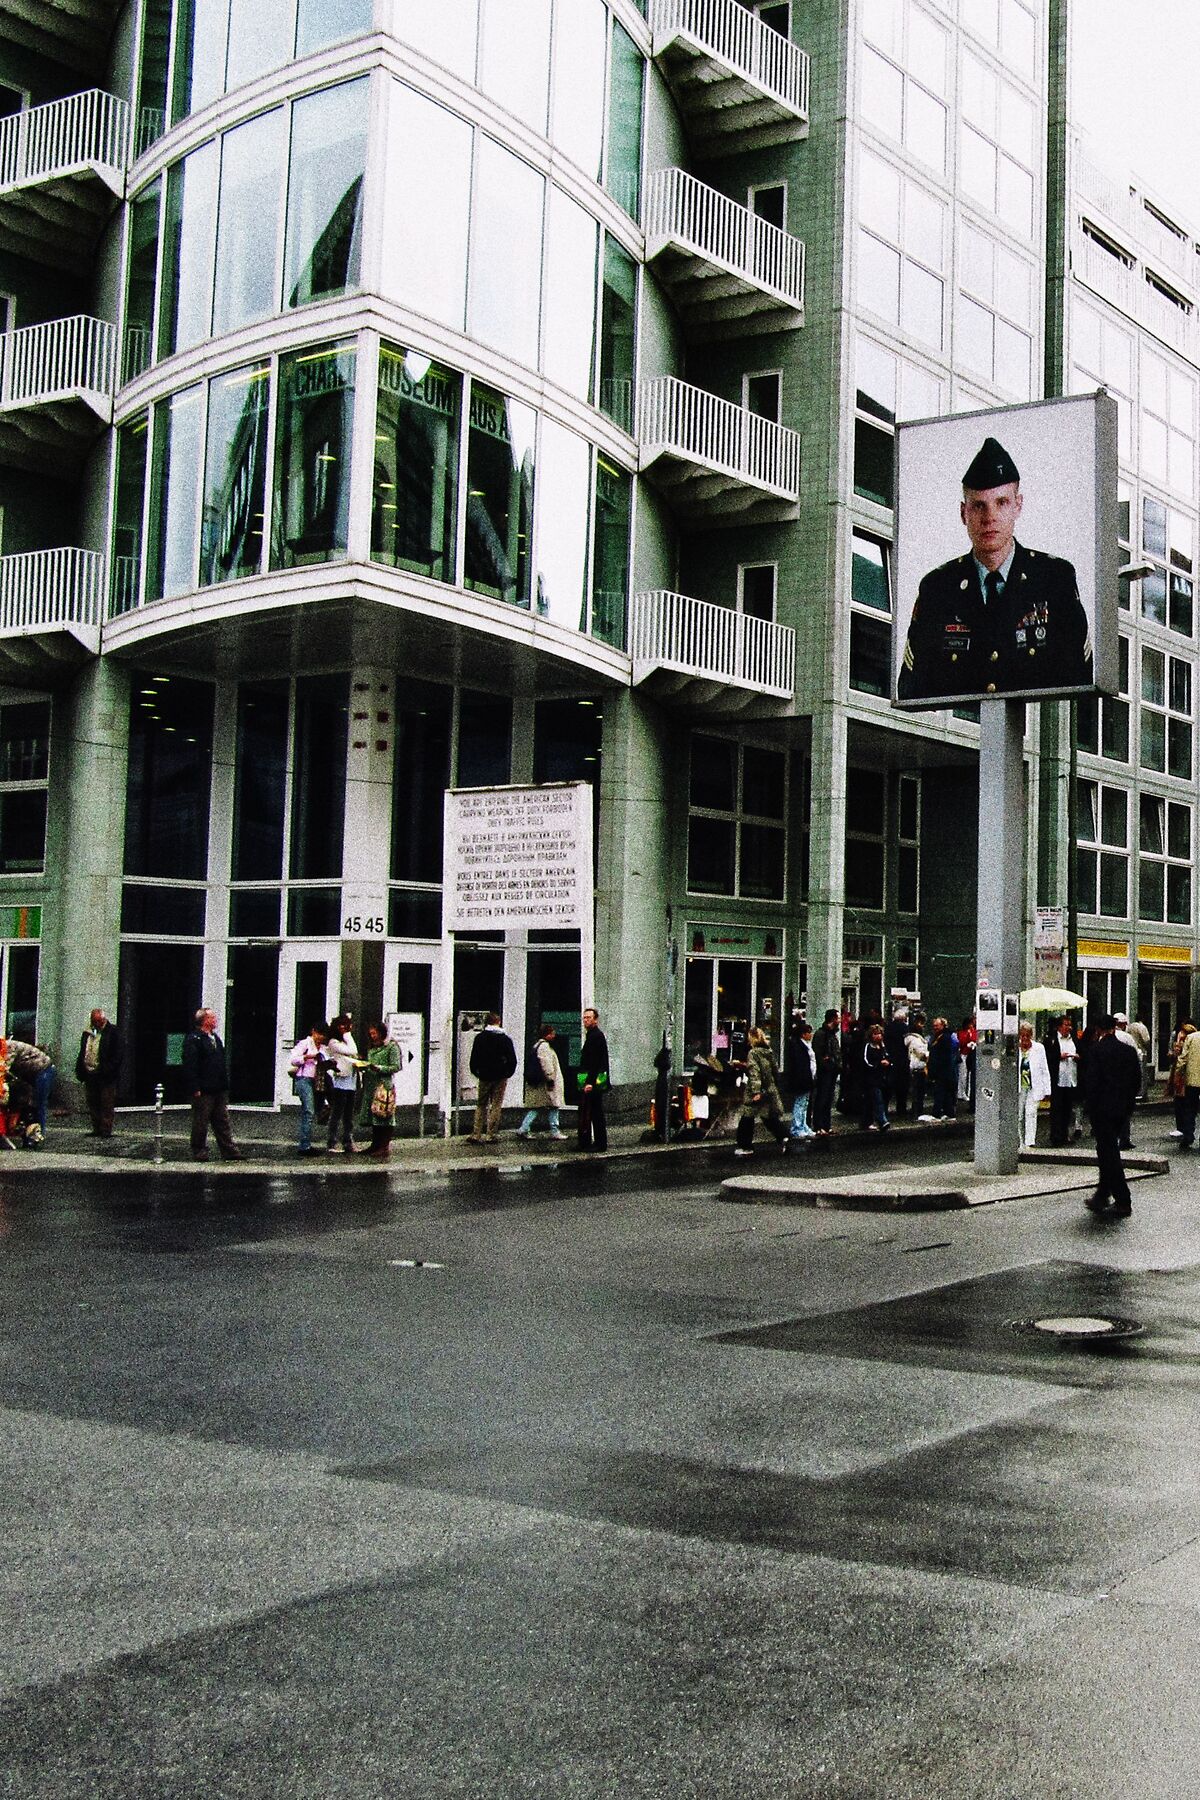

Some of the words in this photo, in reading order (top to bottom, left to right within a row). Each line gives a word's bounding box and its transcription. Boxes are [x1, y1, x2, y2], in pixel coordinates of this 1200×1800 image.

[470, 396, 497, 434] AUS
[344, 917, 361, 932] 45
[365, 917, 384, 933] 45
